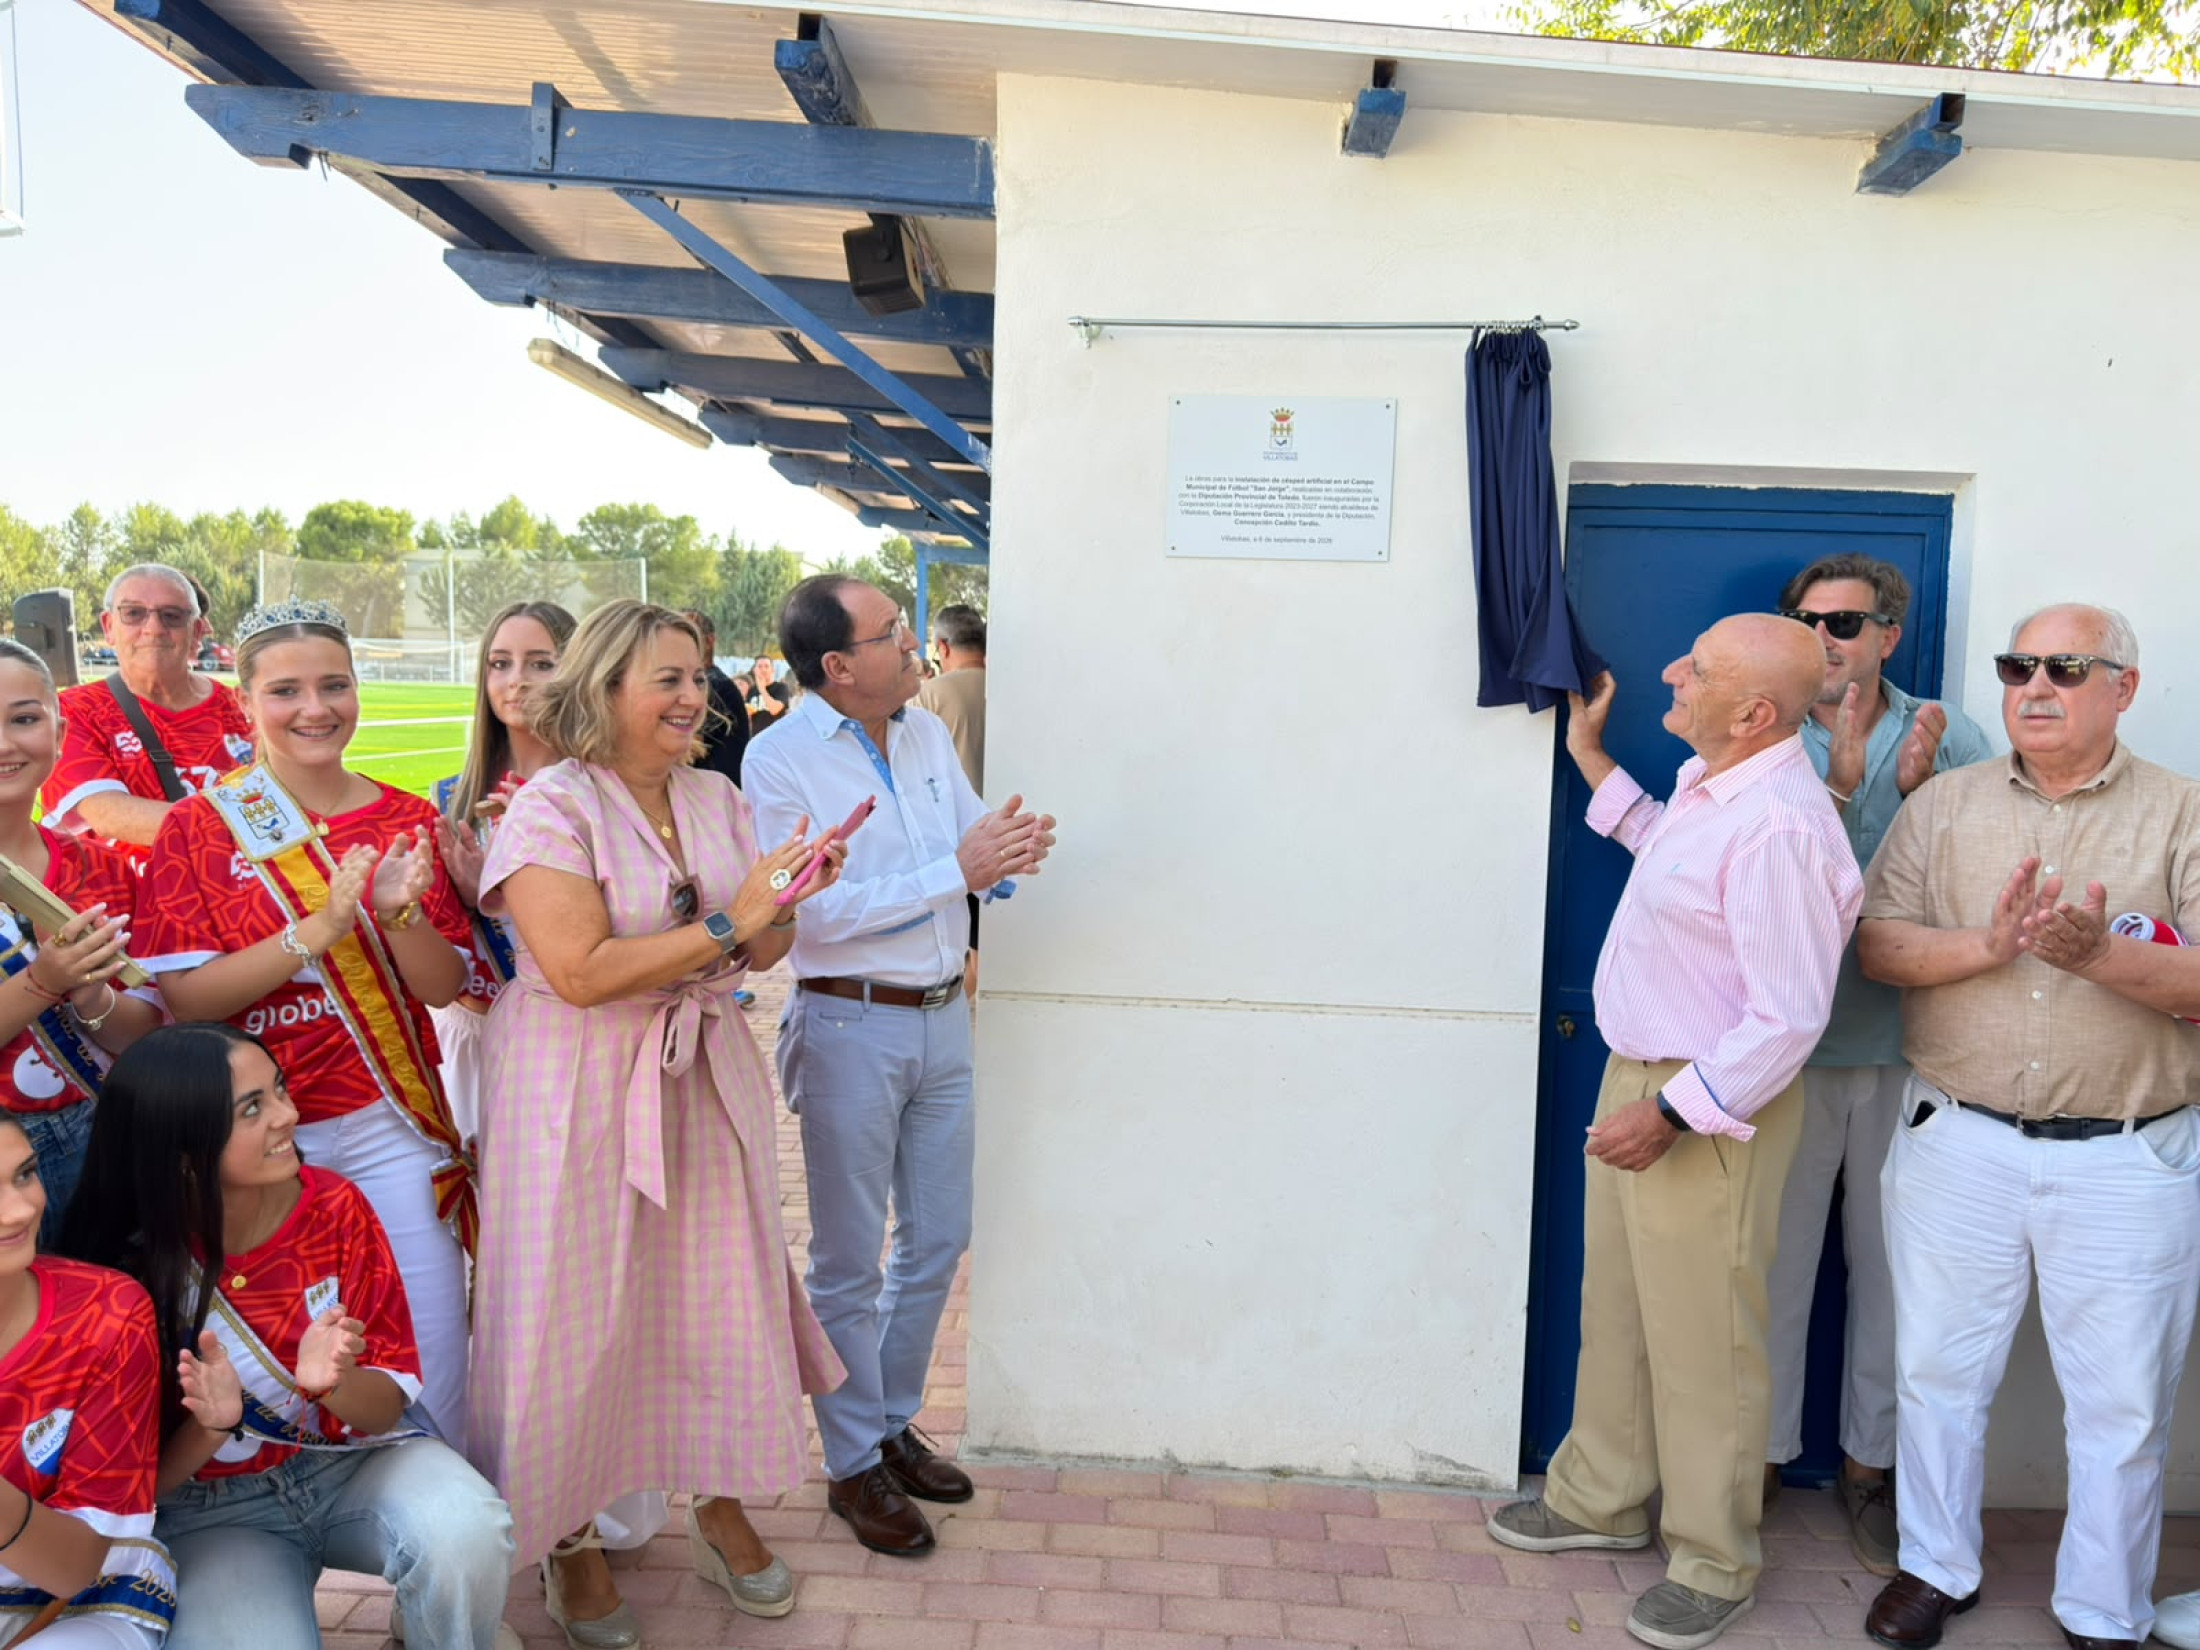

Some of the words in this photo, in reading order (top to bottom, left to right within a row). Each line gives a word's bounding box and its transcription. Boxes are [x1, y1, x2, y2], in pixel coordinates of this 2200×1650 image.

[1351, 478, 1374, 486] Campo
[1186, 483, 1217, 491] Municipal
[1198, 492, 1233, 500] Diputación
[1179, 500, 1215, 508] Corporación
[1233, 509, 1262, 517] Guerrero
[1234, 518, 1273, 526] Concepción
